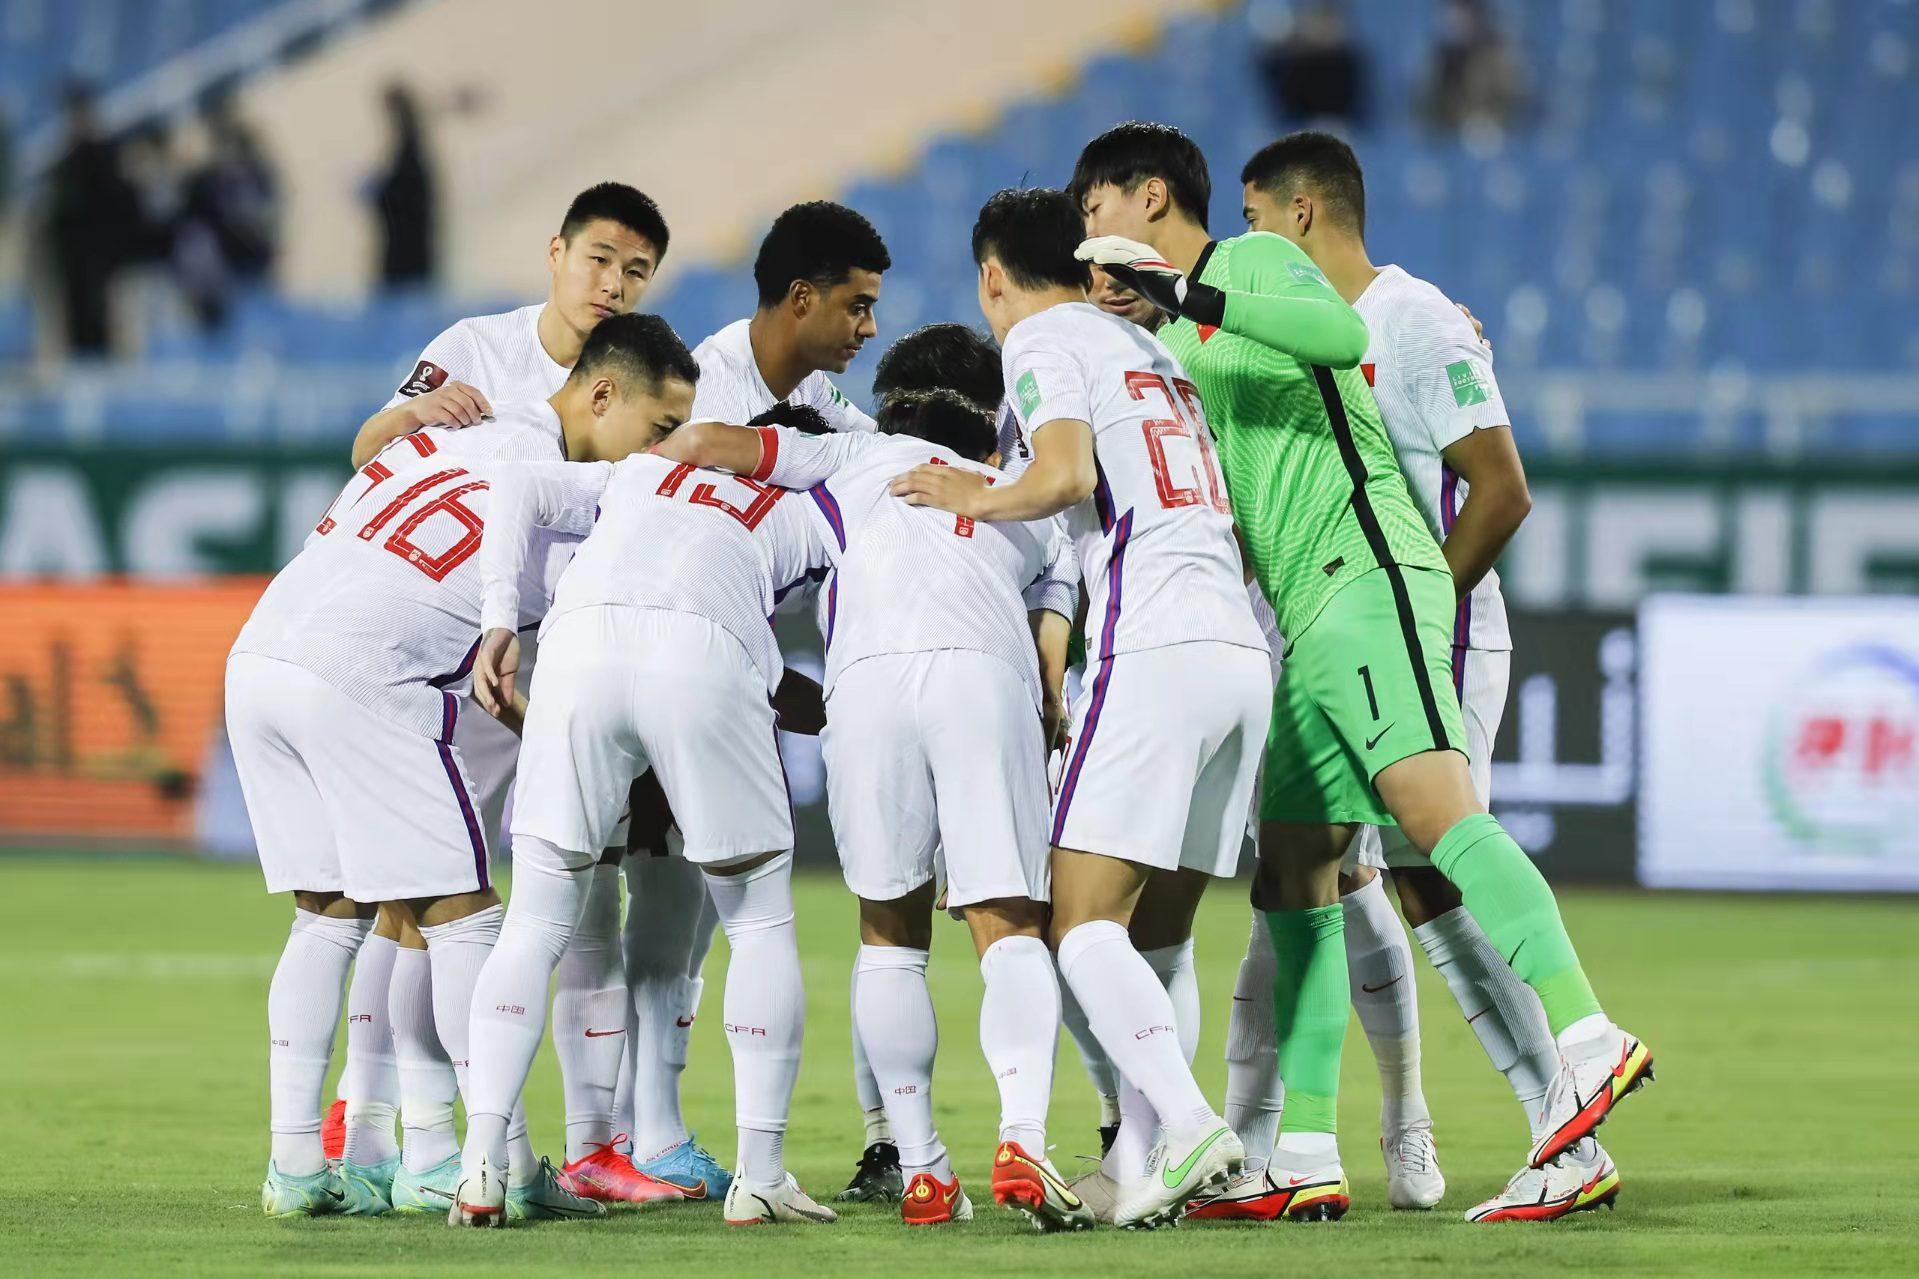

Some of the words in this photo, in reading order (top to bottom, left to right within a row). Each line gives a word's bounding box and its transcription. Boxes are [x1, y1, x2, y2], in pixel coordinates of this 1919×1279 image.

[357, 467, 490, 582] 16
[1357, 665, 1380, 721] 1
[495, 1005, 525, 1016] 中国
[725, 1023, 766, 1036] CFA
[1135, 1025, 1174, 1040] CFA
[894, 1085, 917, 1095] 中国
